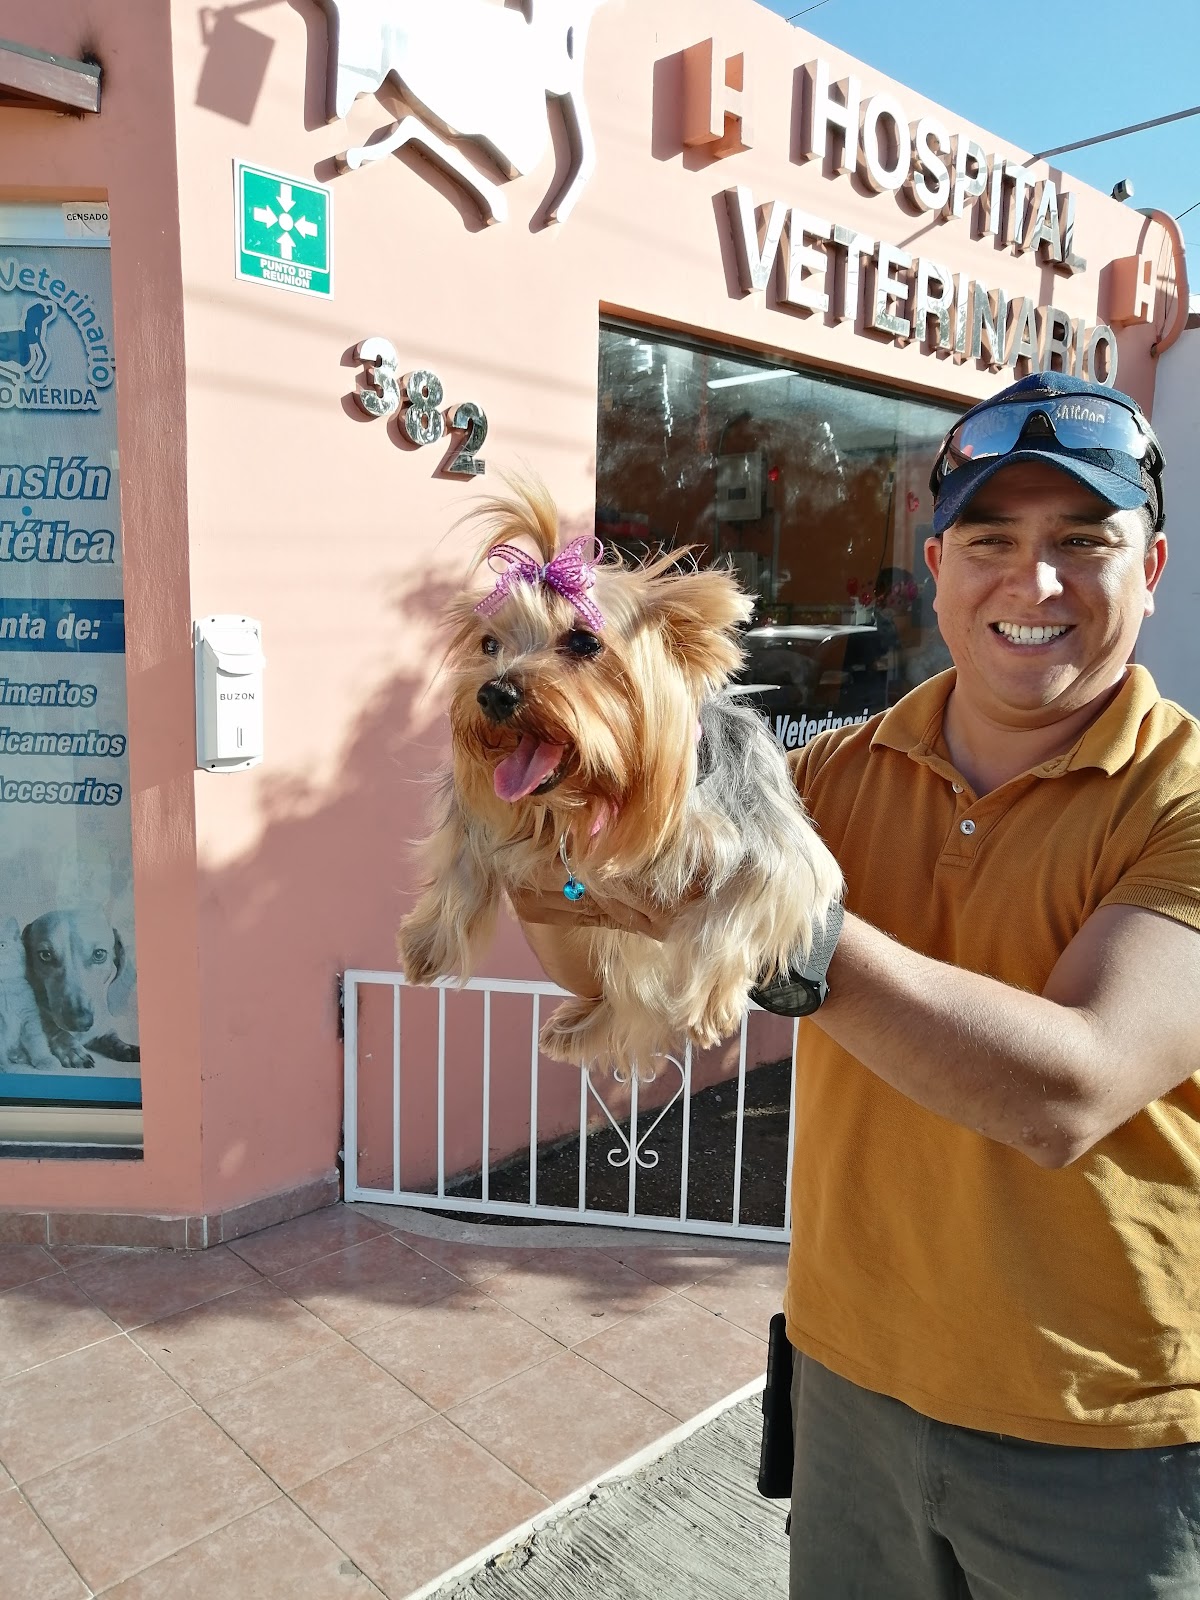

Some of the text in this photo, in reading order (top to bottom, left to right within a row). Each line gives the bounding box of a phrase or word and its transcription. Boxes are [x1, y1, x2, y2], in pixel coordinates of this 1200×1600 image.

[811, 58, 1087, 274] HOSPITAL
[66, 213, 108, 221] CENSADO
[260, 259, 313, 280] PUNTO DE
[262, 269, 310, 289] REUNION
[737, 186, 1118, 388] VETERINARIO
[0, 261, 109, 382] Veterinario
[19, 384, 97, 405] MÉRIDA
[358, 337, 488, 475] 382
[56, 613, 101, 640] de:
[219, 692, 255, 701] BUZON
